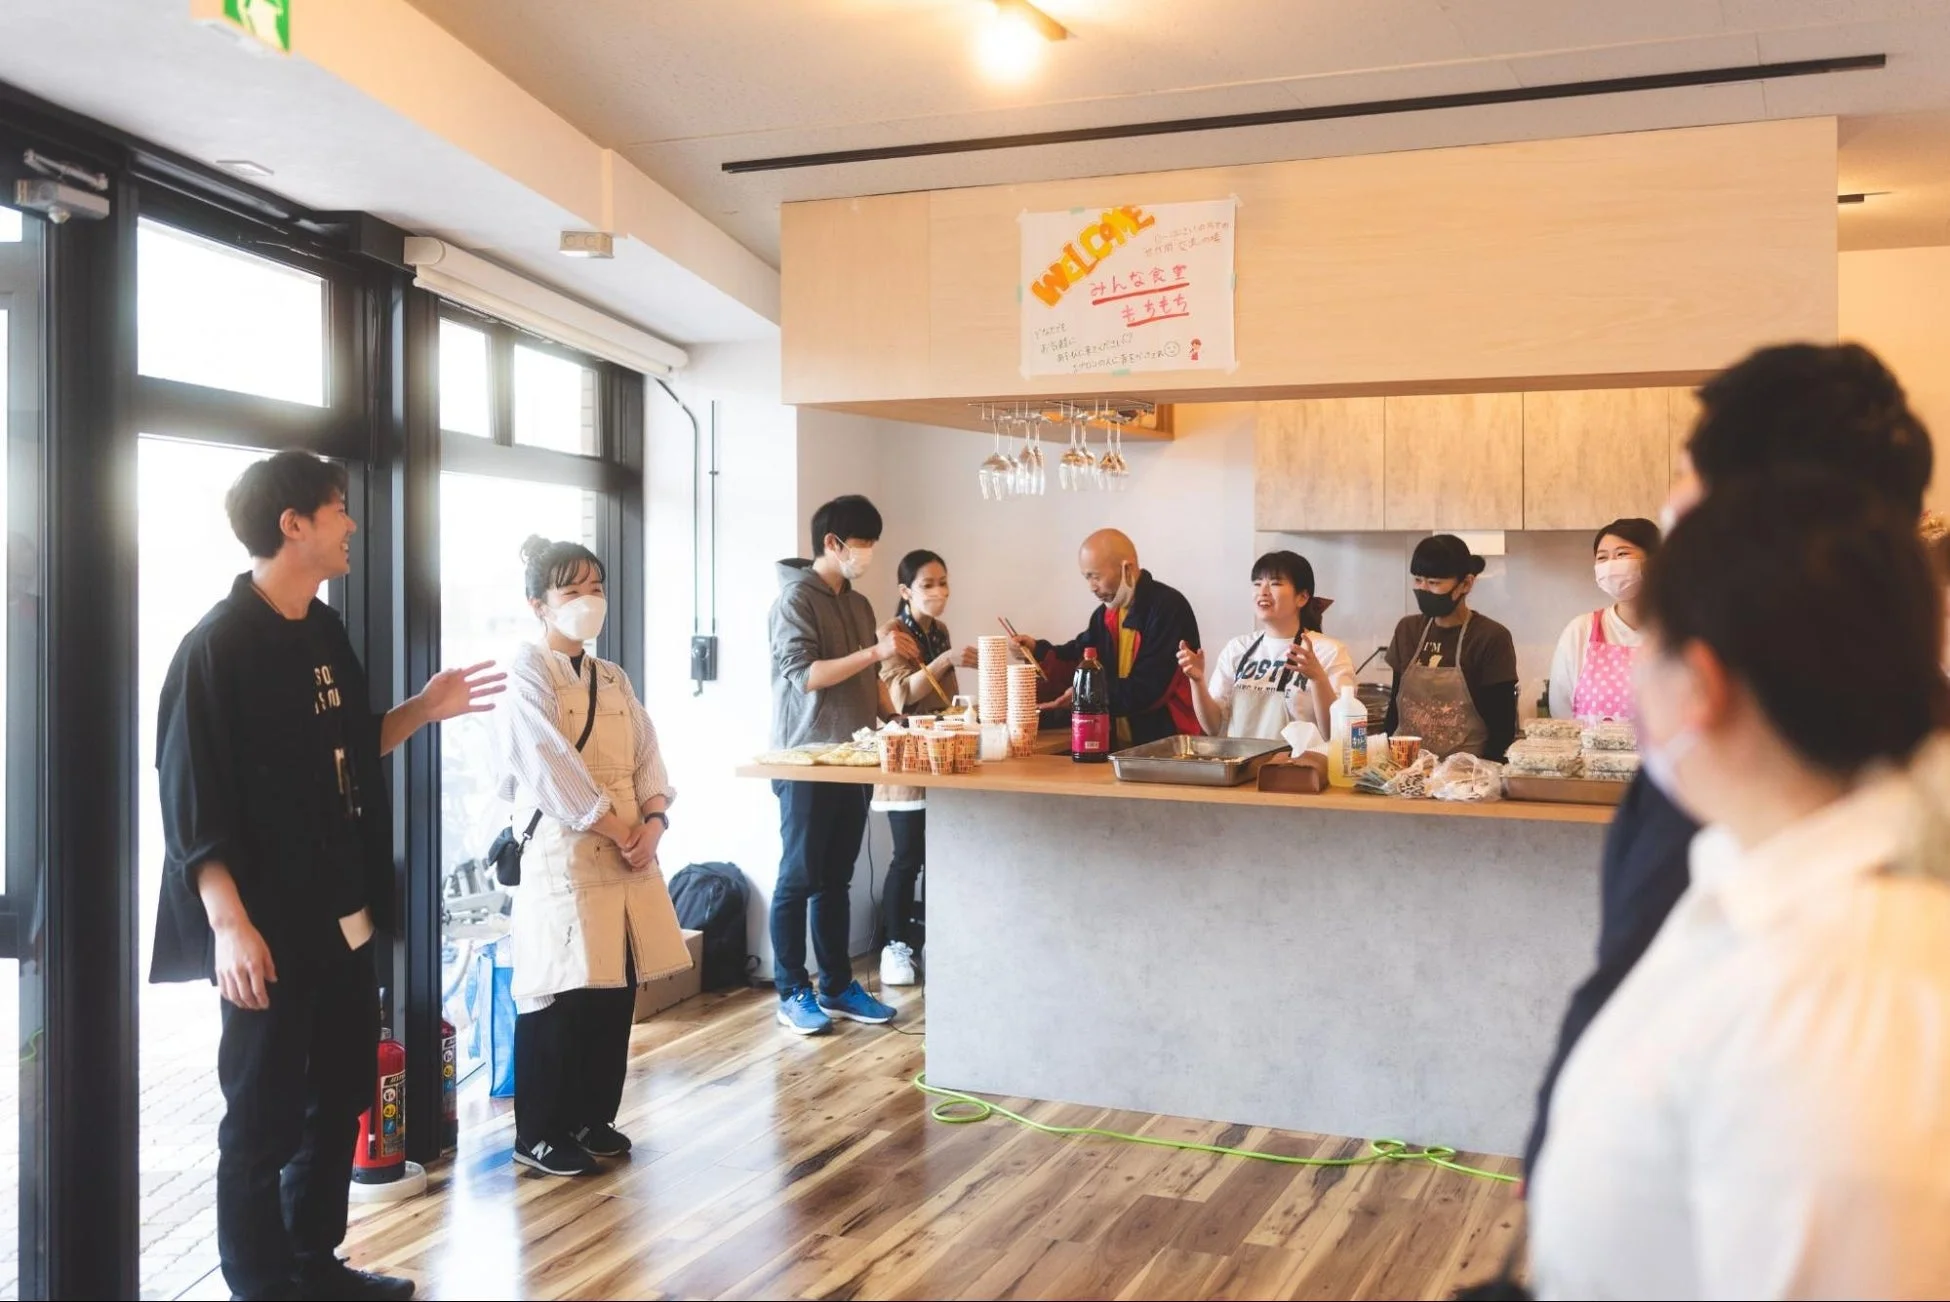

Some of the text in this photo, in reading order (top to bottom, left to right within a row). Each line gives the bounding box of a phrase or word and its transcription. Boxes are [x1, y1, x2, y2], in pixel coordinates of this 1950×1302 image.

[1031, 204, 1156, 308] WELCOME
[1088, 264, 1187, 296] みんな食堂
[1120, 293, 1187, 322] もちもち
